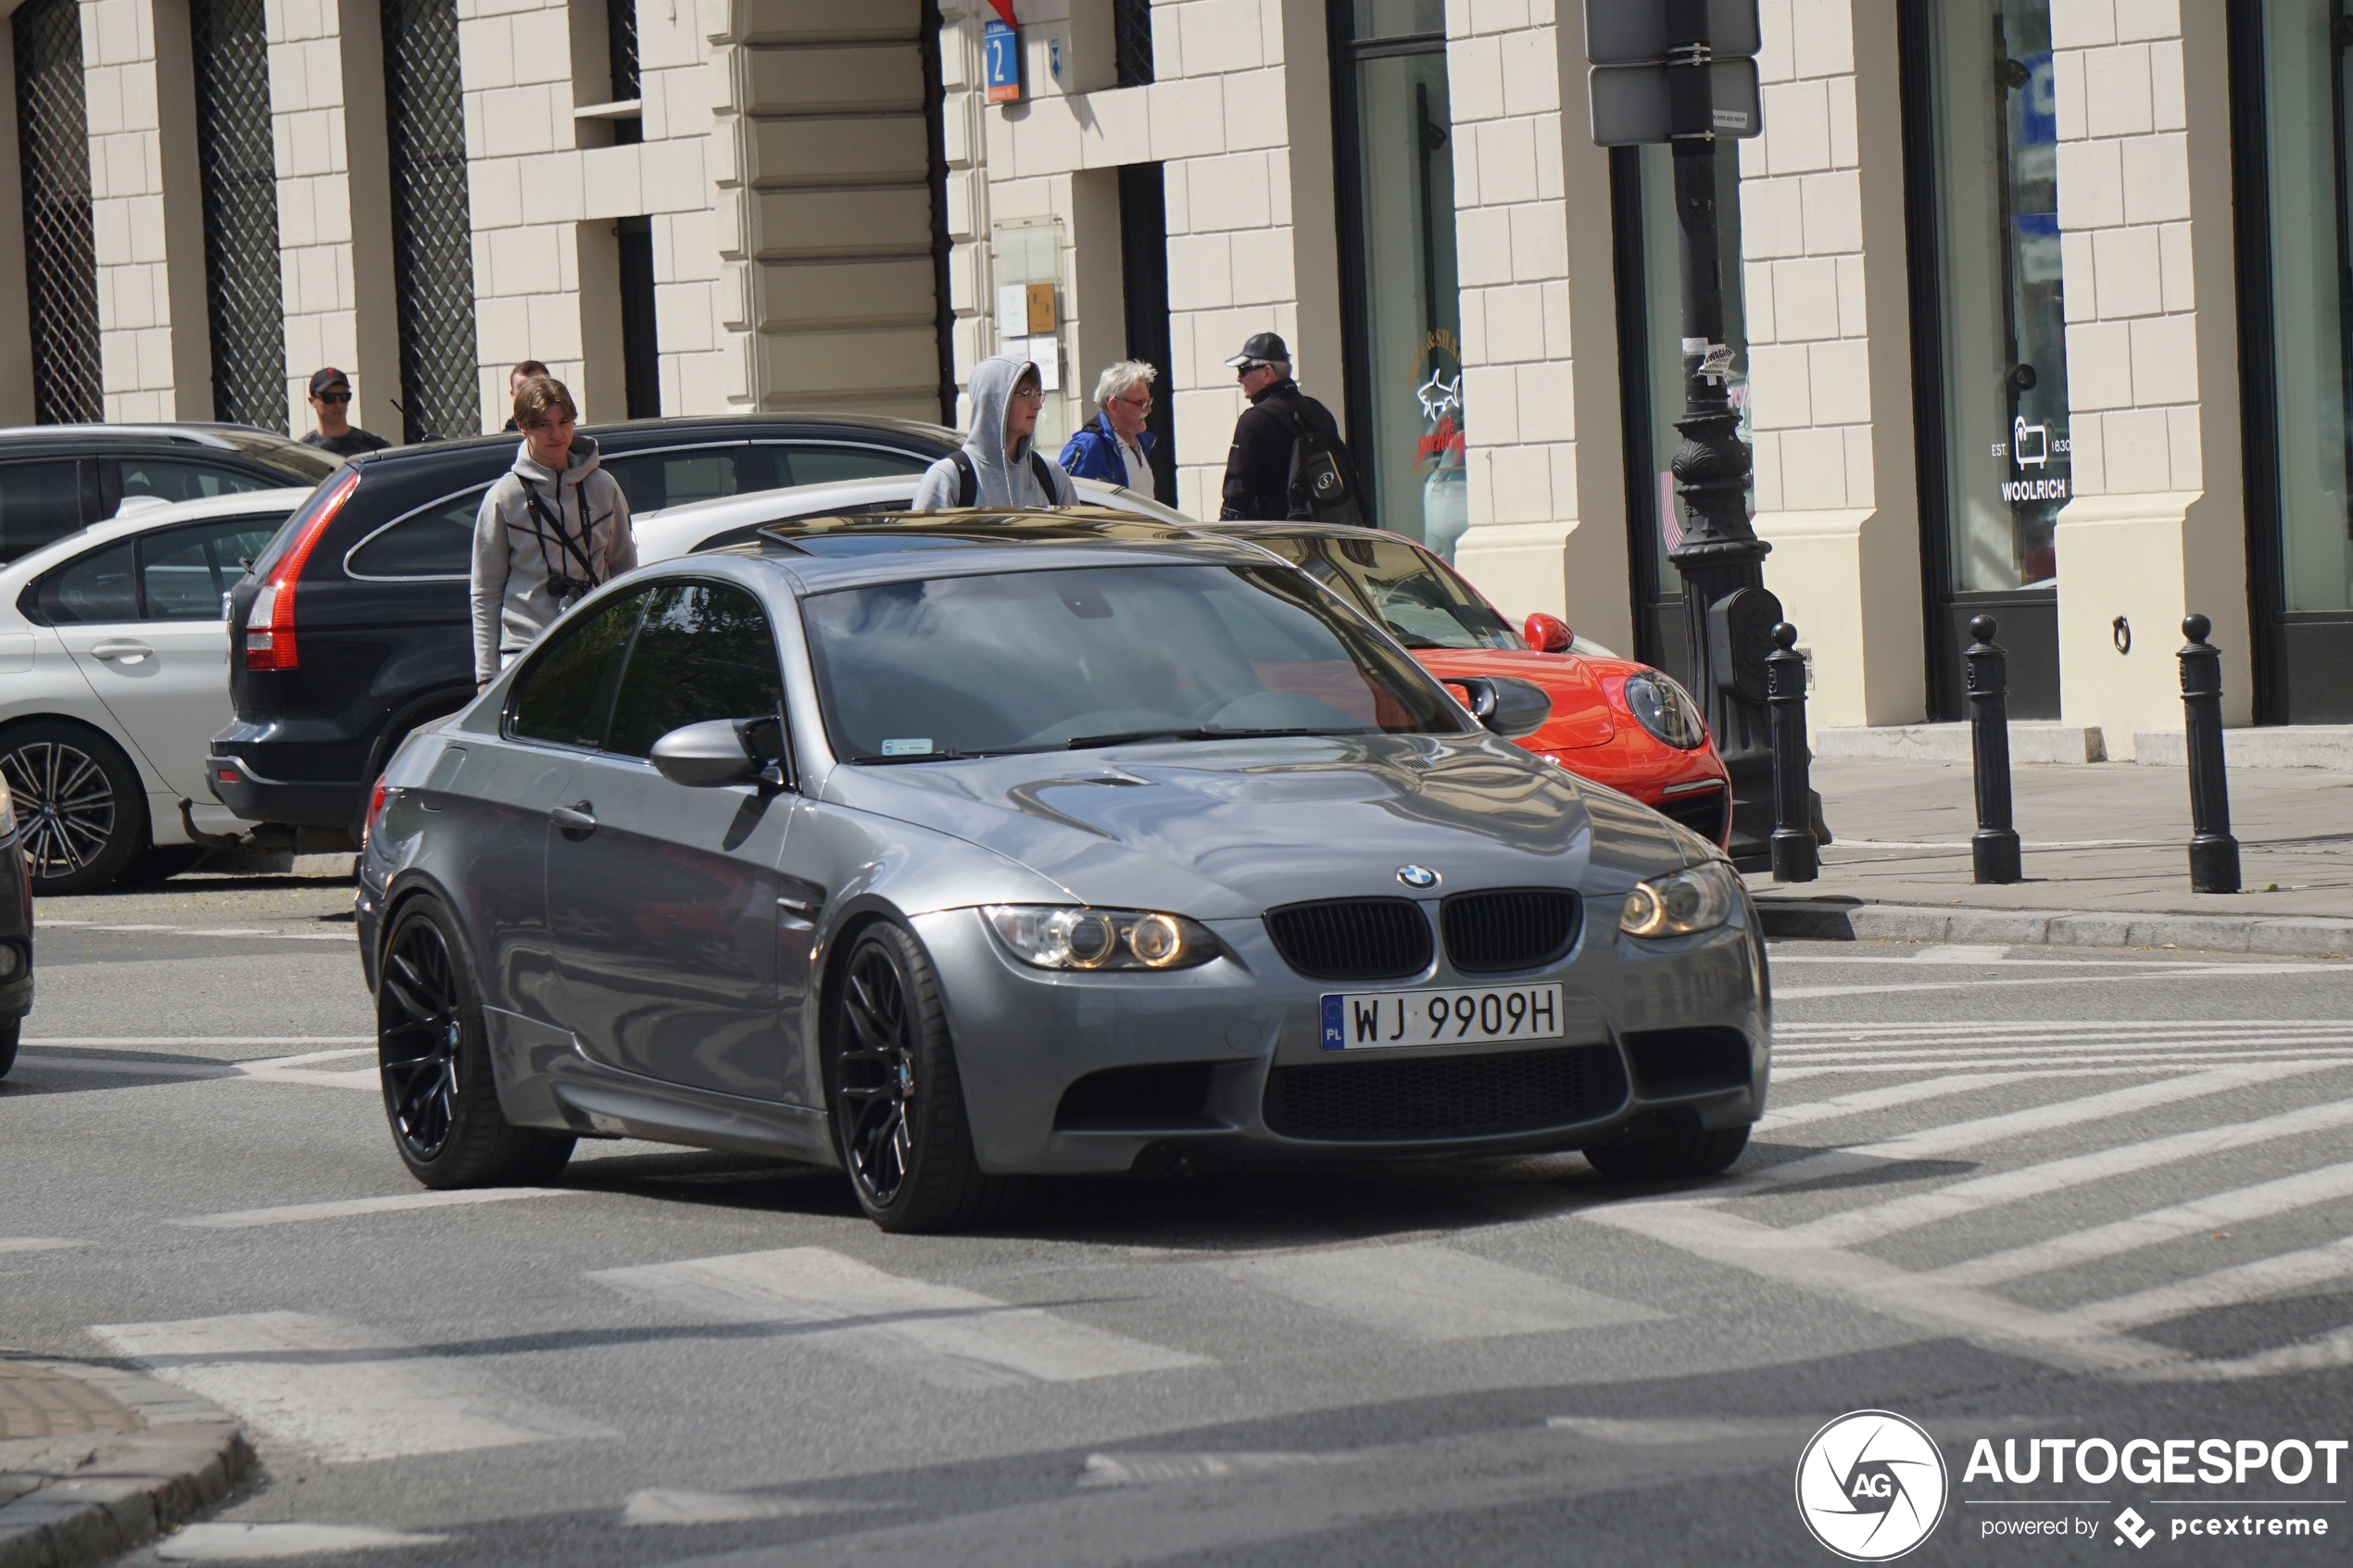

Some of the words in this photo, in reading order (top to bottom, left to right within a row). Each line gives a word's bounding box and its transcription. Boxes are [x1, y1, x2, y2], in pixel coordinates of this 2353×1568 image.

[993, 40, 1004, 82] 2
[1992, 444, 2007, 457] EST.
[2051, 439, 2071, 452] 1830
[2002, 479, 2066, 501] WOOLRICH
[1354, 998, 1405, 1043] WJ
[1428, 989, 1554, 1039] 9909H
[1327, 1029, 1342, 1041] PL
